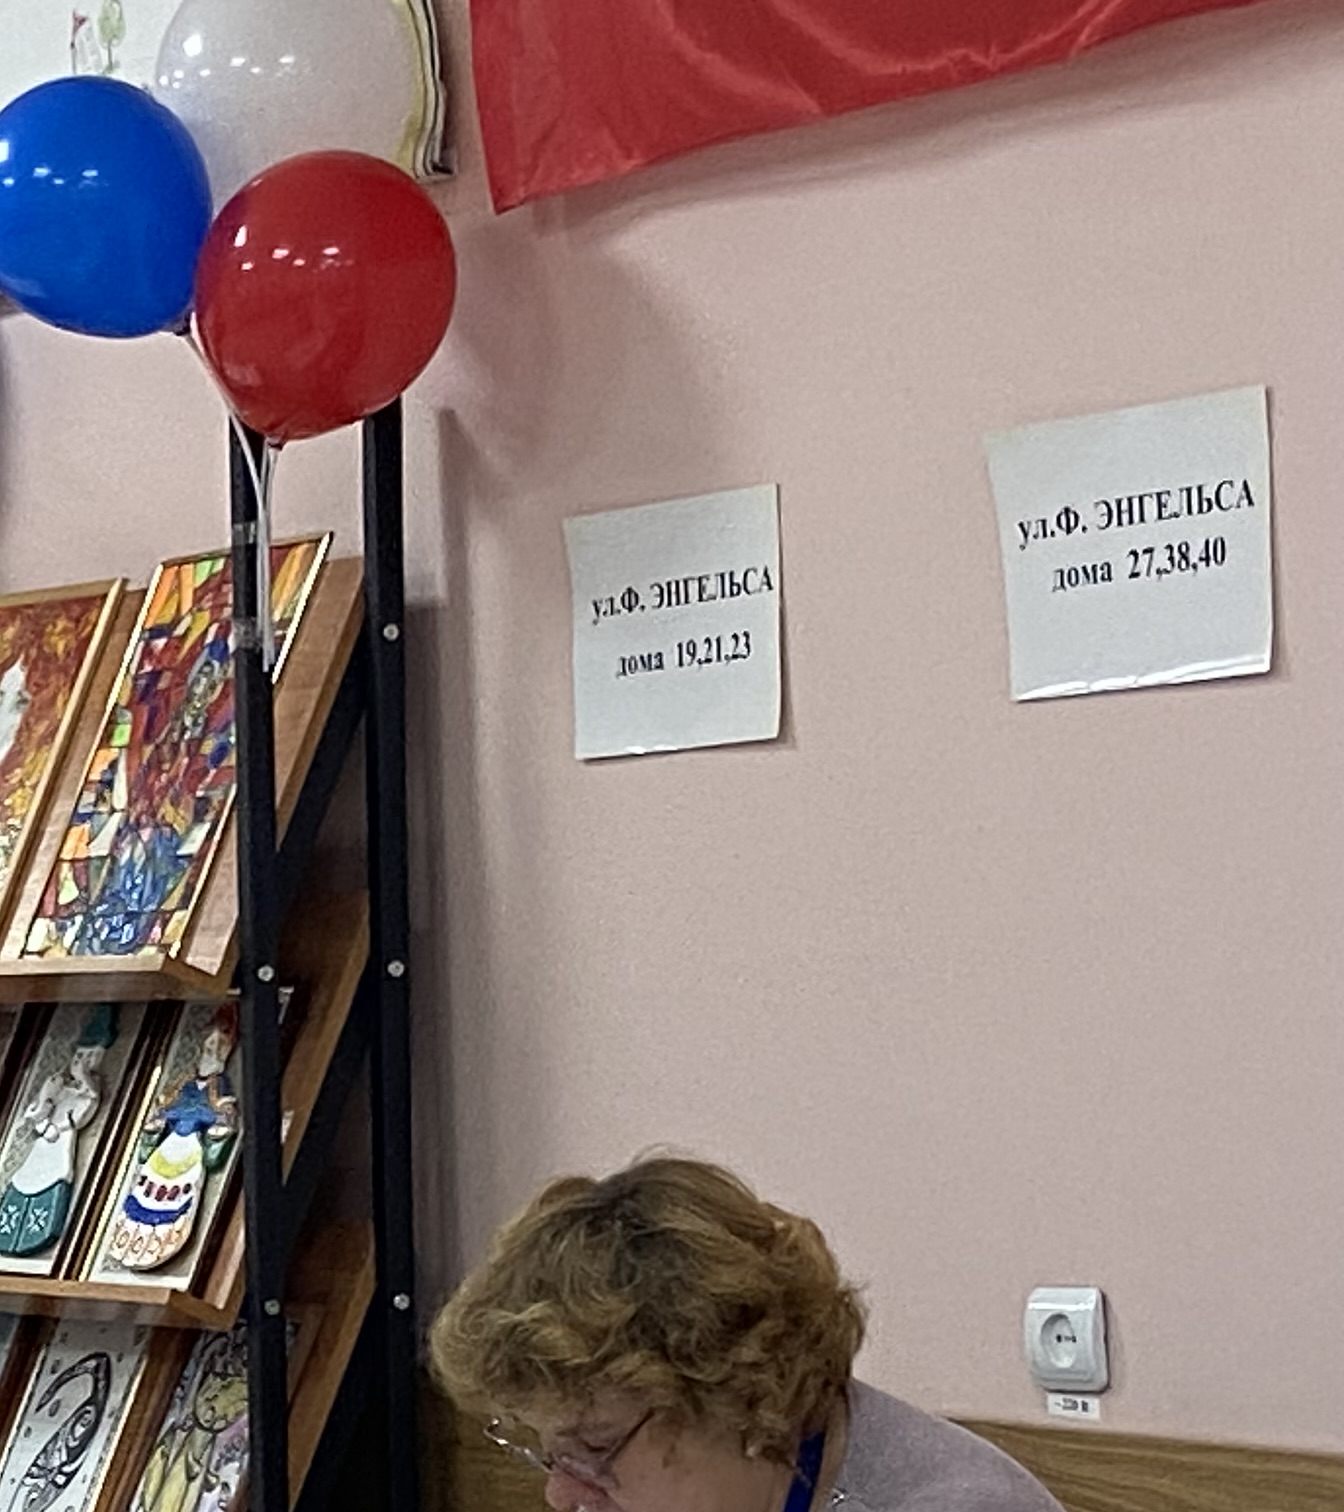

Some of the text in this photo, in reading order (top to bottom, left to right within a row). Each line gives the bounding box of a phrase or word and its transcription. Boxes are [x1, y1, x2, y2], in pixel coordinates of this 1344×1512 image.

[1017, 478, 1256, 551] ул.Ф. ЭНГЕЛЬСА
[1052, 536, 1227, 593] дома 27,38,40
[591, 565, 774, 625] ул.Ф. ЭНГЕЛЬСА
[615, 630, 752, 678] дома 19,21,23
